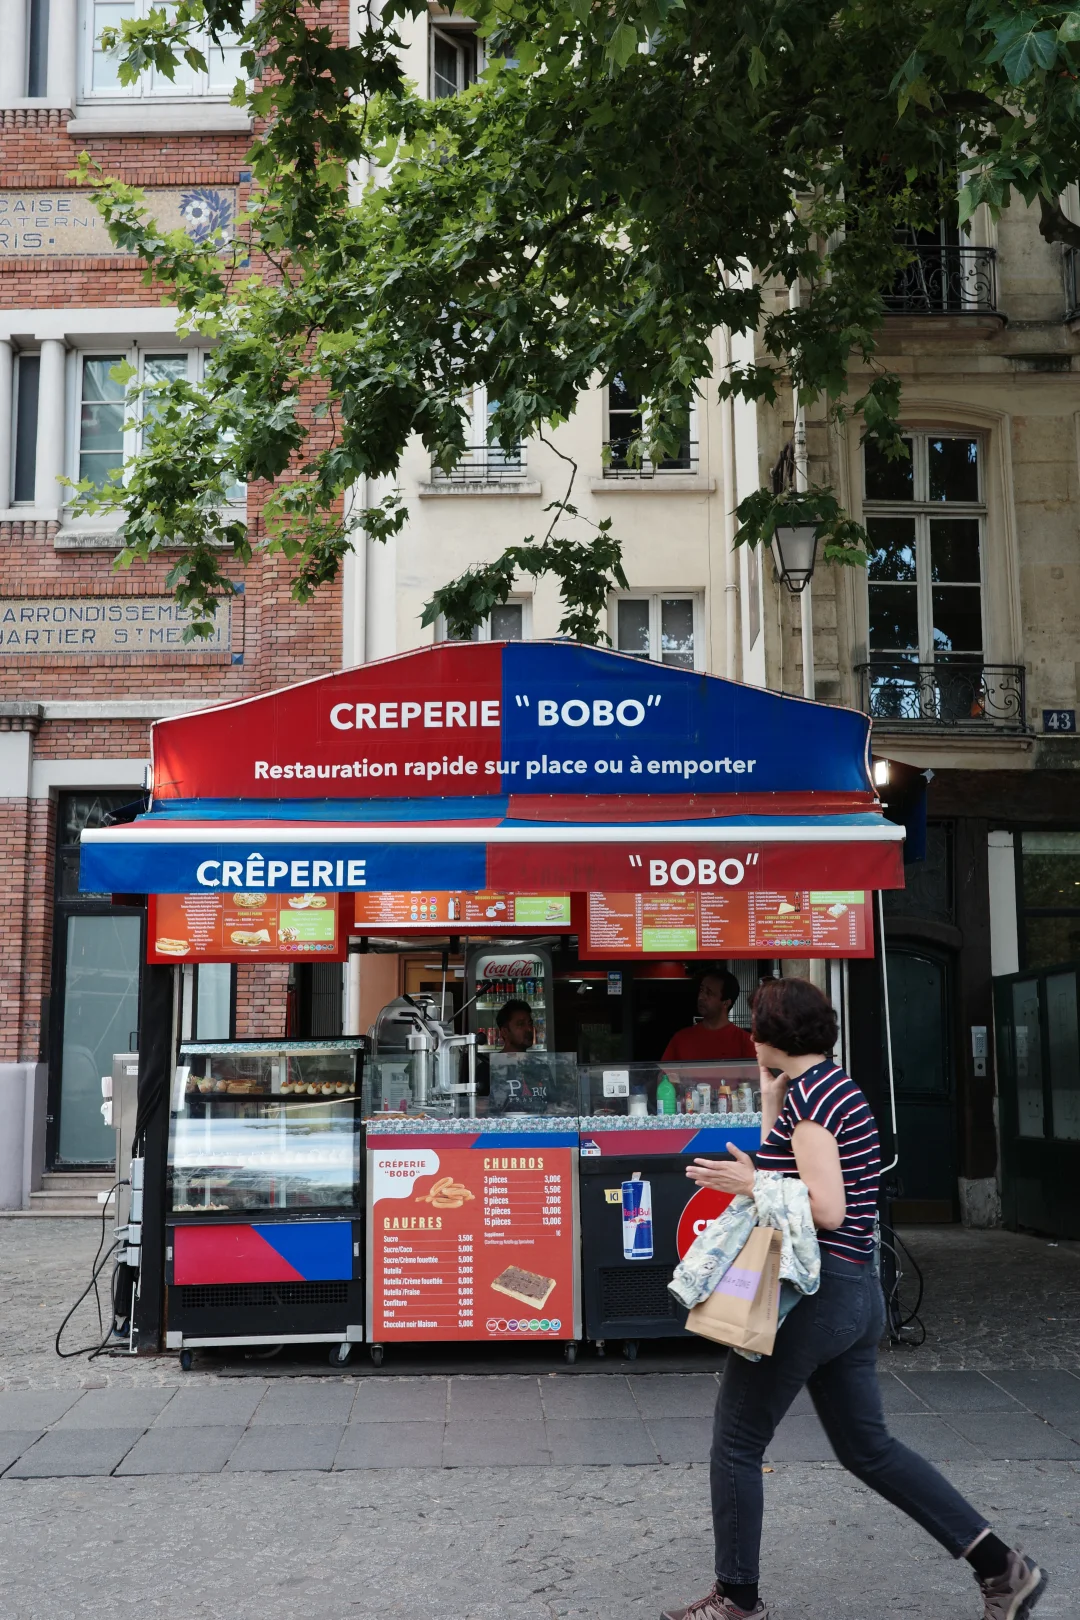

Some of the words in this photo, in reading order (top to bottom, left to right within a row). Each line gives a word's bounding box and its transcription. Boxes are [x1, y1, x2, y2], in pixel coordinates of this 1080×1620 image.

[0, 628, 96, 645] ARTIER
[149, 627, 221, 643] MEI
[329, 700, 500, 730] CREPERIE
[1047, 712, 1071, 730] 43
[254, 758, 397, 779] Restauration
[404, 755, 478, 781] rapide
[484, 759, 520, 775] sur
[526, 754, 588, 780] place
[593, 759, 623, 774] ou
[629, 755, 643, 774] à
[646, 757, 757, 779] emporter
[196, 852, 367, 887] CRÊPERIE
[483, 960, 533, 979] Coca-Cola
[483, 1157, 544, 1169] CHURROS
[483, 1176, 488, 1184] 3
[488, 1175, 508, 1185] pièces
[544, 1175, 561, 1183] 3,00€
[483, 1186, 488, 1194] 6
[488, 1186, 508, 1195] pièces
[544, 1185, 561, 1194] 5,50€
[483, 1197, 488, 1205] 9
[488, 1196, 509, 1206] pièces
[546, 1196, 561, 1204] 7,00€
[483, 1207, 491, 1215] 12
[491, 1207, 511, 1216] pièces
[542, 1206, 561, 1215] 10,00€
[624, 1208, 637, 1216] Red
[638, 1208, 651, 1216] Bul
[383, 1216, 443, 1229] GAUFRES
[483, 1217, 491, 1226] 15
[491, 1217, 511, 1227] pièces
[542, 1217, 562, 1225] 13,00€
[693, 1219, 717, 1236] C
[458, 1234, 473, 1242] 3,50€
[417, 1255, 438, 1263] fouettée
[458, 1255, 473, 1263] 5,00€
[458, 1266, 473, 1274] 5,00€
[421, 1277, 443, 1285] fouettée
[418, 1320, 437, 1328] Maison
